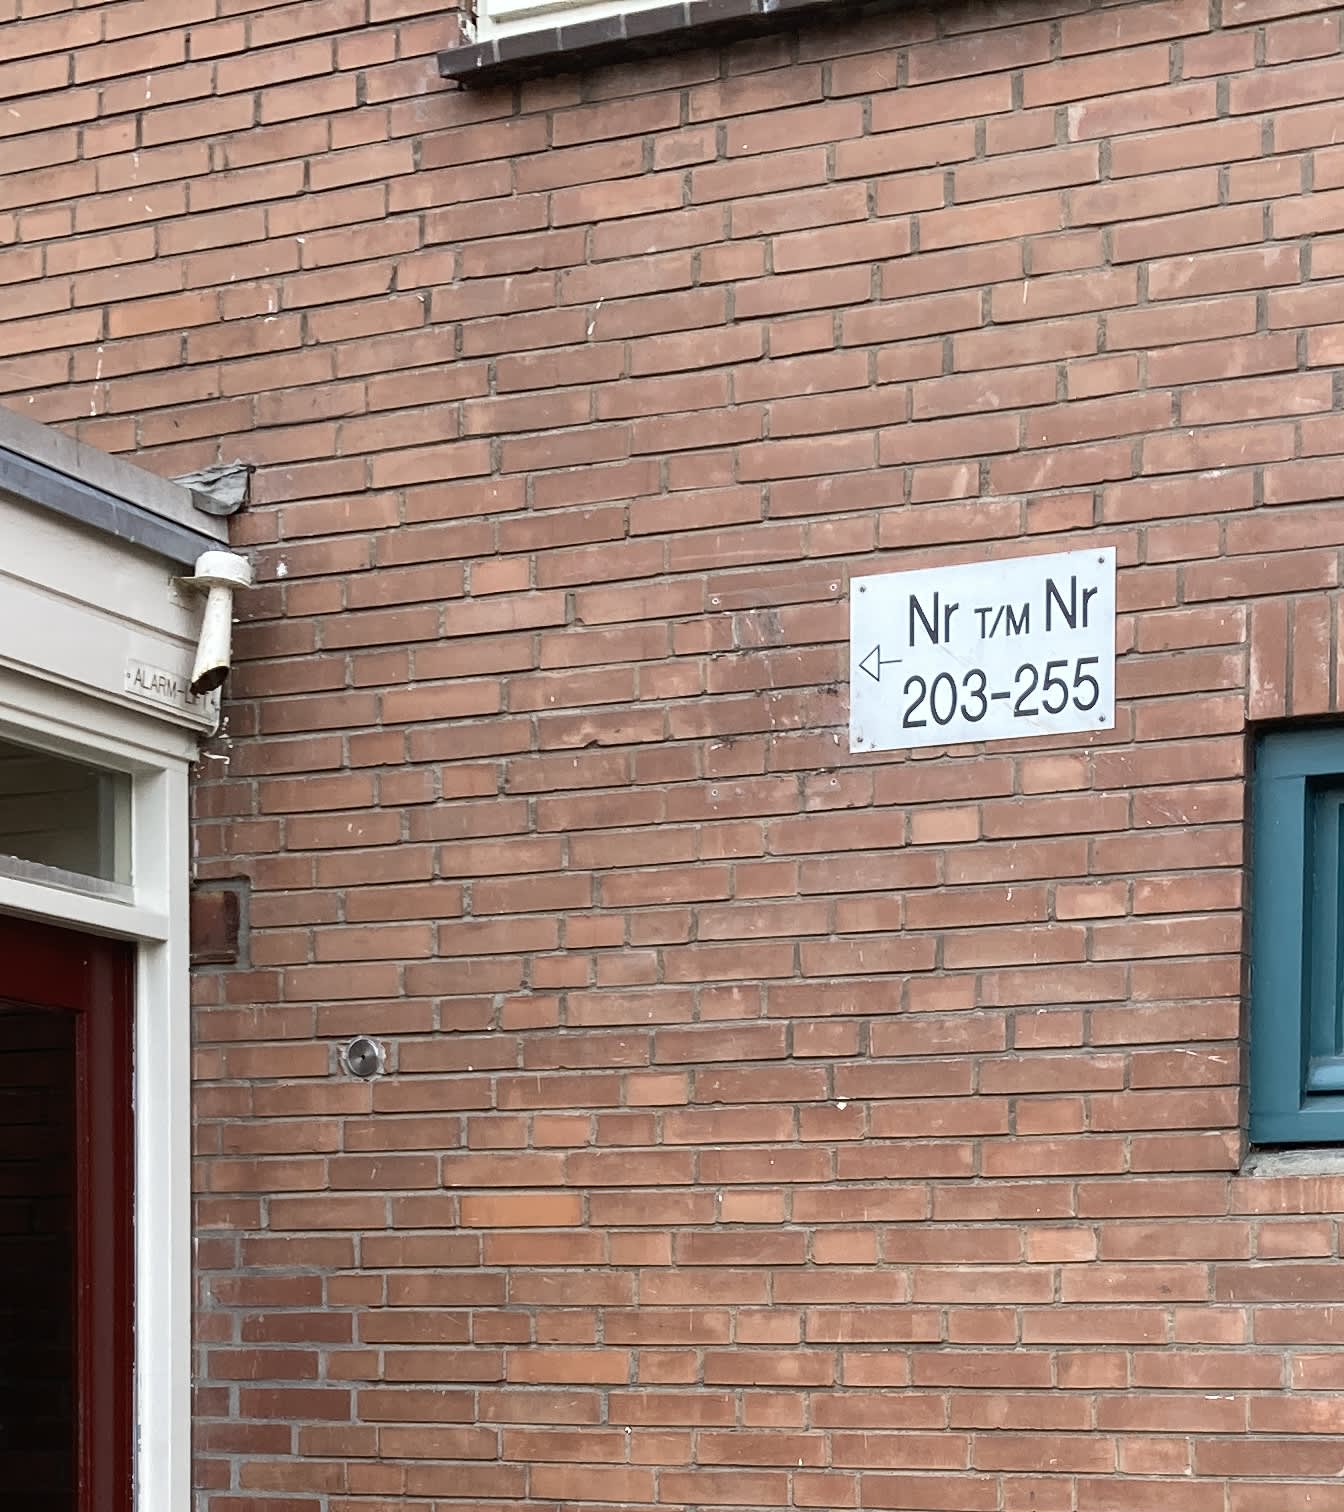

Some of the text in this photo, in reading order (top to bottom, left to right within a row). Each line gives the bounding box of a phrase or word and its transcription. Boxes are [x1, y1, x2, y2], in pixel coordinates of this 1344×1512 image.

[909, 575, 1098, 647] Nr T/M Nr
[902, 656, 1099, 729] 203-255
